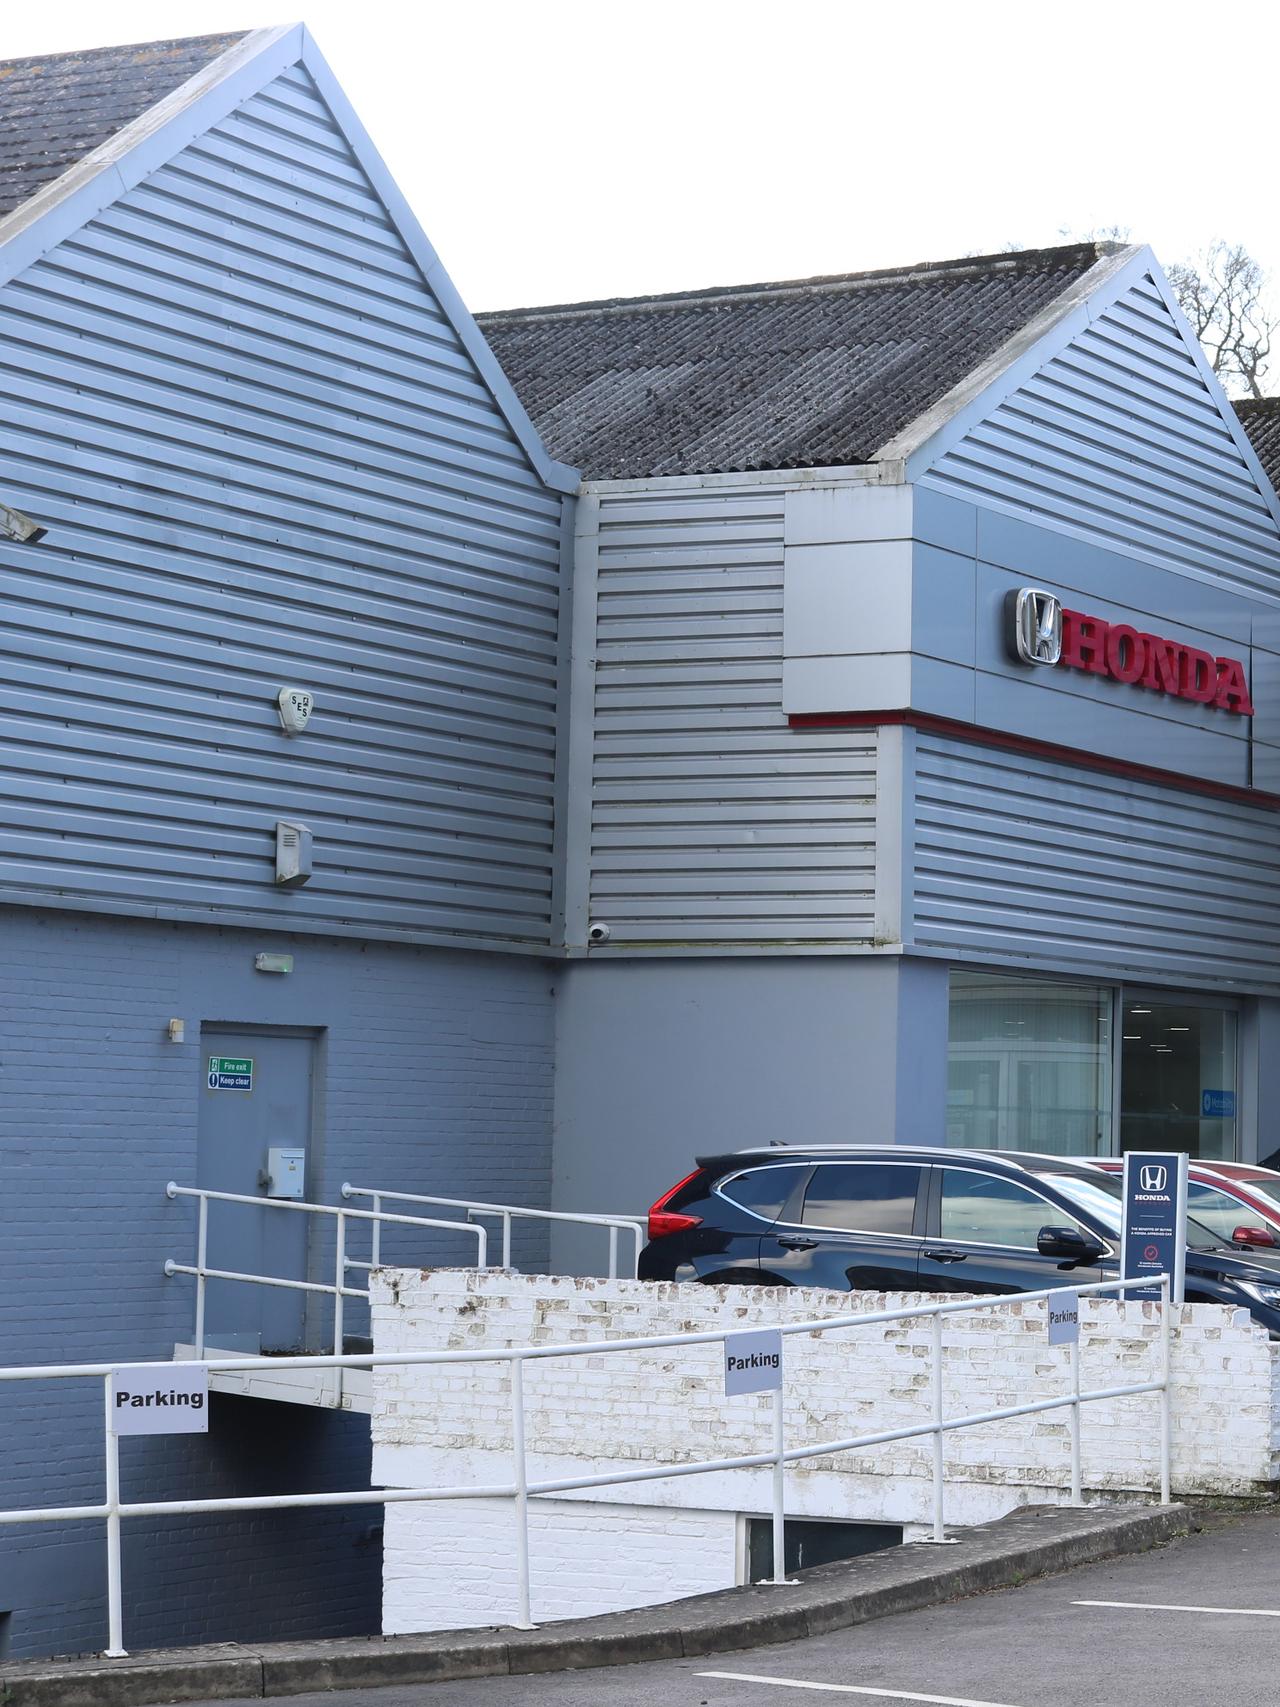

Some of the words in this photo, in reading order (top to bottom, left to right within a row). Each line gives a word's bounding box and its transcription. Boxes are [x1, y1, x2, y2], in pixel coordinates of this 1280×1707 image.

[1060, 608, 1254, 716] HONDA
[224, 1062, 235, 1070] Fire
[236, 1063, 247, 1071] exit
[220, 1076, 234, 1086] Keep
[236, 1076, 249, 1085] clear
[1050, 1309, 1077, 1324] Parking
[727, 1352, 779, 1371] Parking
[116, 1390, 204, 1409] Parking
